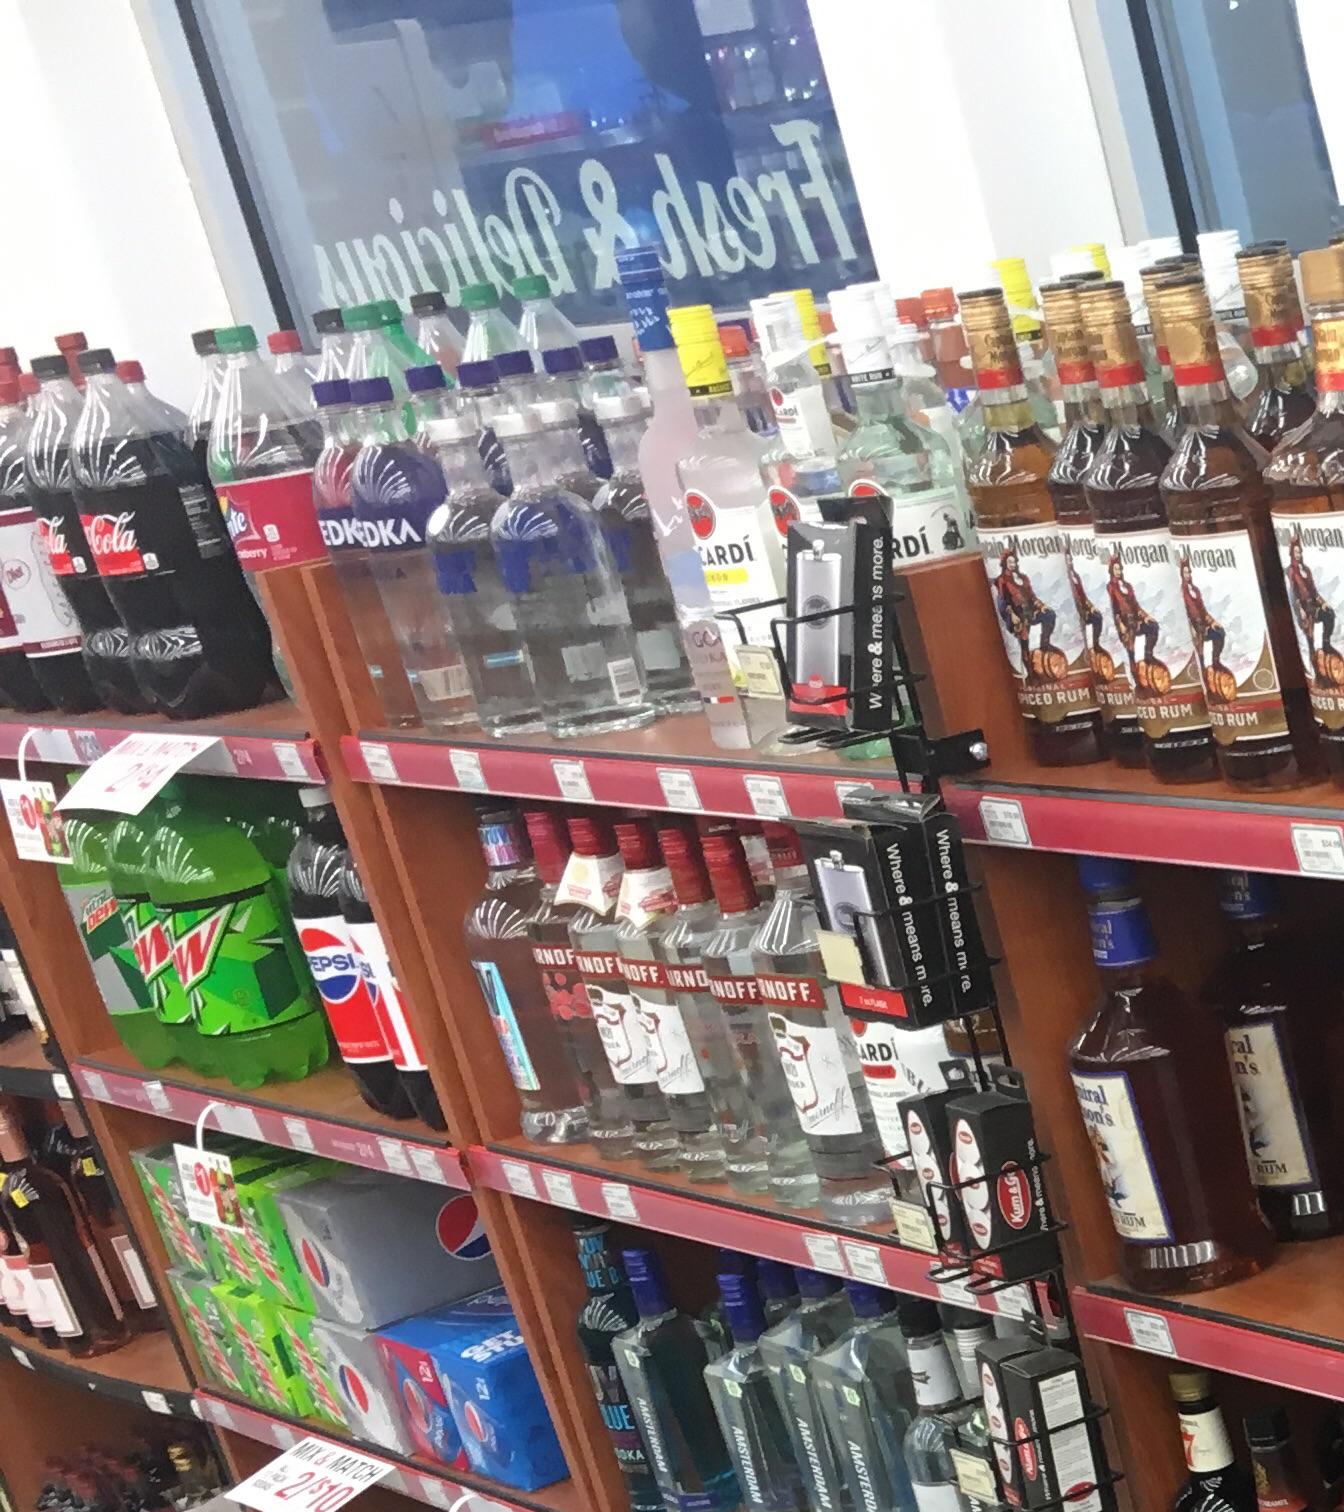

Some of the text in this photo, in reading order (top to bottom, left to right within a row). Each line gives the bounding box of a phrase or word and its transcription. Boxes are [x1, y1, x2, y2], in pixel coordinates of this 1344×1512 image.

[1008, 535, 1061, 558] Morgan
[1291, 522, 1343, 551] Morgan
[1112, 543, 1170, 567] Morgan
[1183, 546, 1235, 570] Morgan
[1055, 688, 1091, 704] RUM
[1160, 703, 1192, 719] RUM
[1226, 711, 1258, 727] RUM
[886, 843, 922, 962] Where & means
[936, 829, 964, 948] Where & means
[290, 1441, 320, 1462] MIX
[328, 1455, 384, 1483] MATCH
[732, 1426, 764, 1504] AMSTERDAM
[796, 1417, 832, 1509] AMSTERDAM
[274, 1471, 354, 1512] 2/$10
